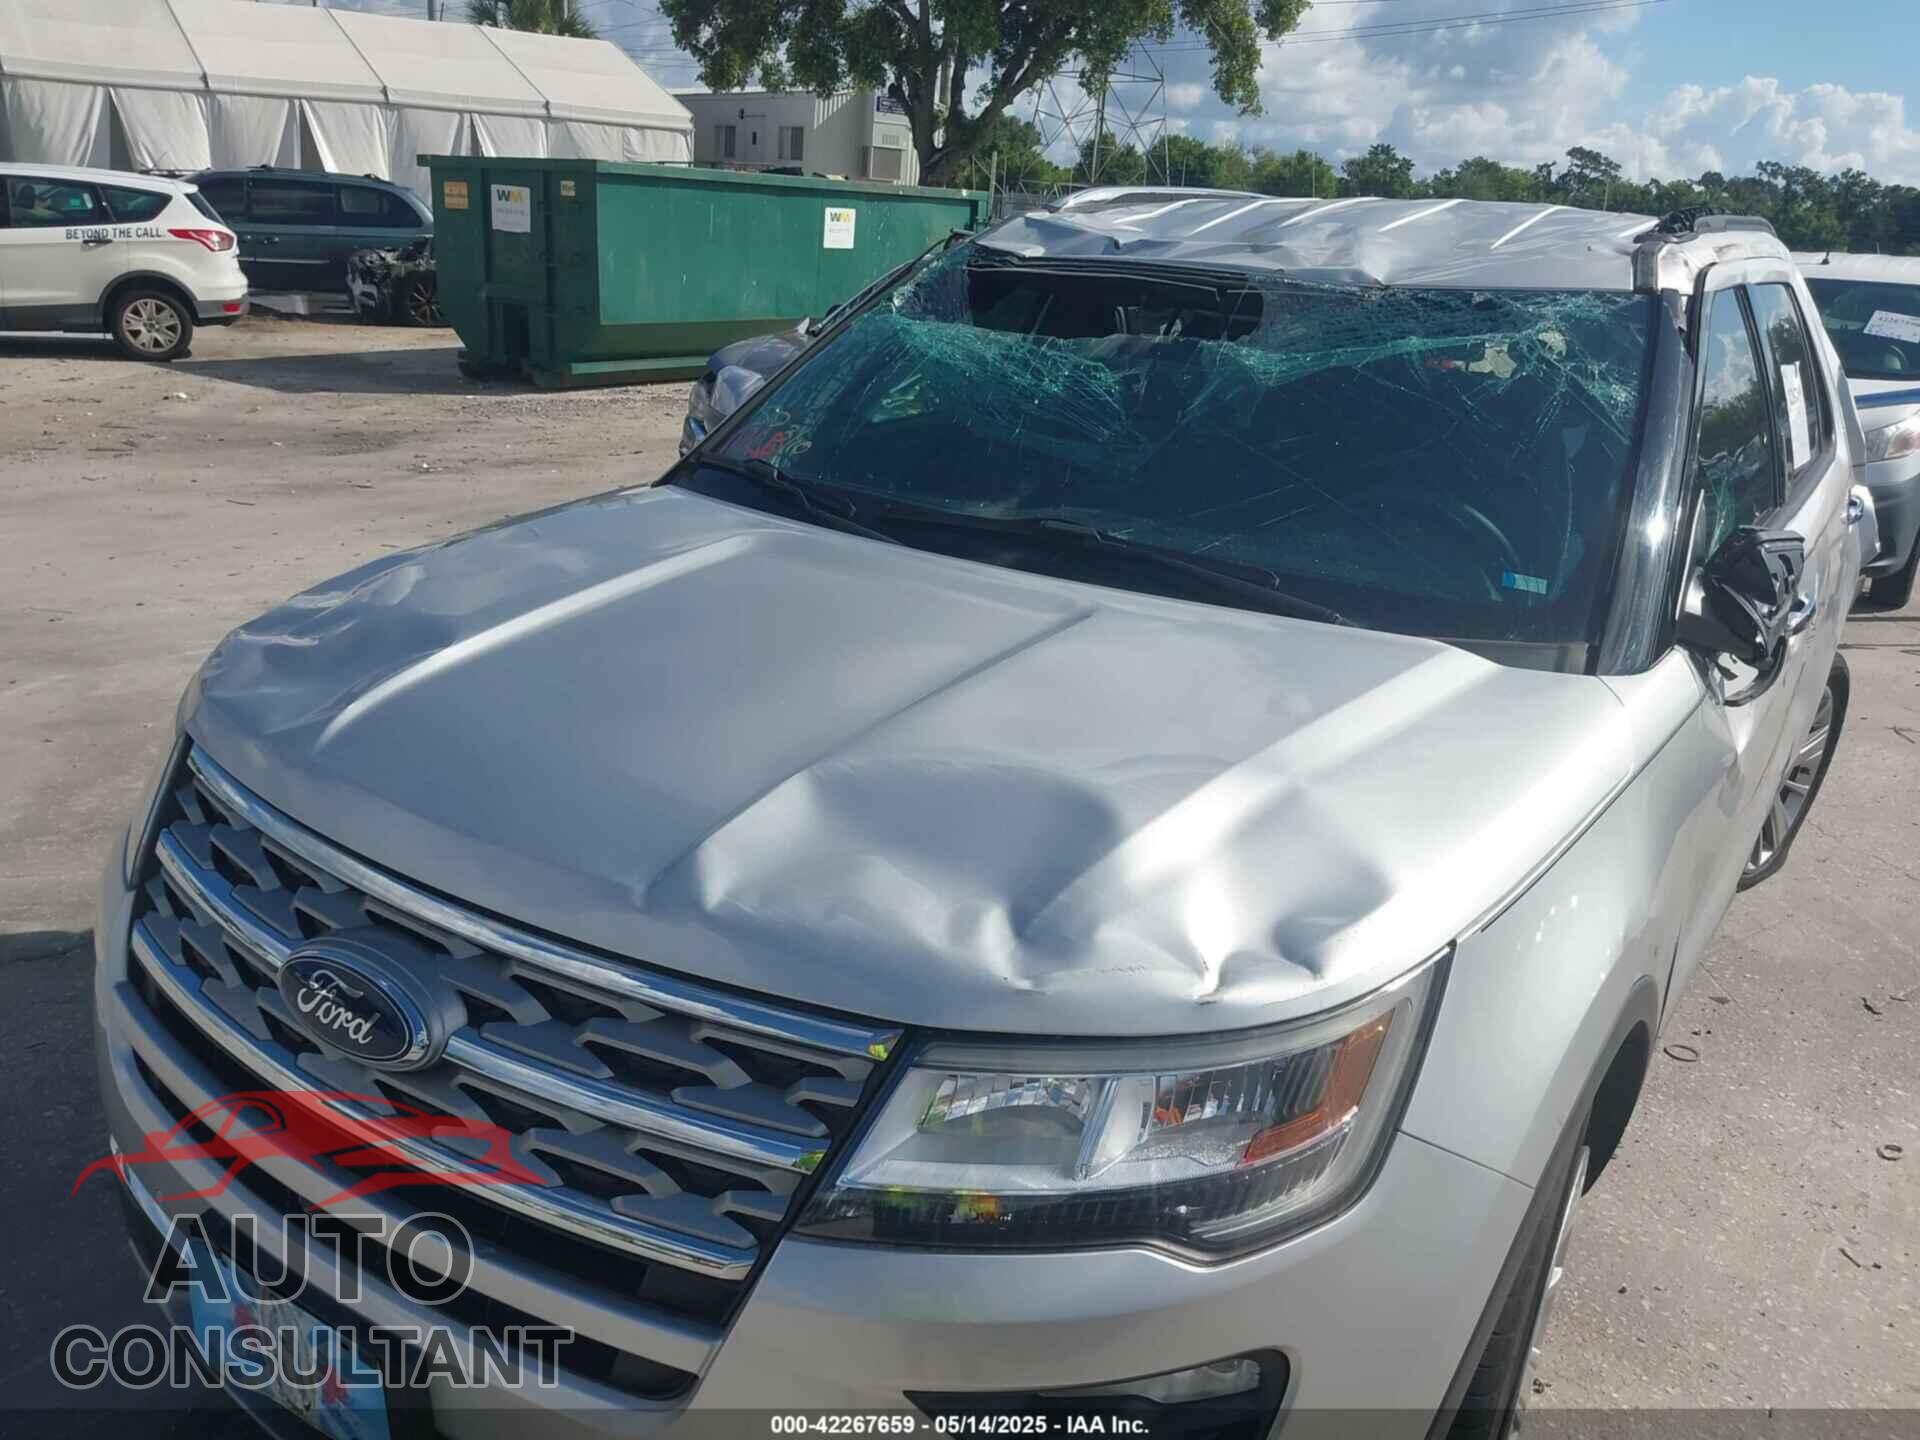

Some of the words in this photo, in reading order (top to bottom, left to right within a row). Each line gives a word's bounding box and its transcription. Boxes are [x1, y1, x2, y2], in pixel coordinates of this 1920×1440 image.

[65, 228, 109, 240] BEYOND
[112, 228, 132, 239] THE
[135, 227, 161, 238] CALL
[297, 969, 382, 1044] Ford
